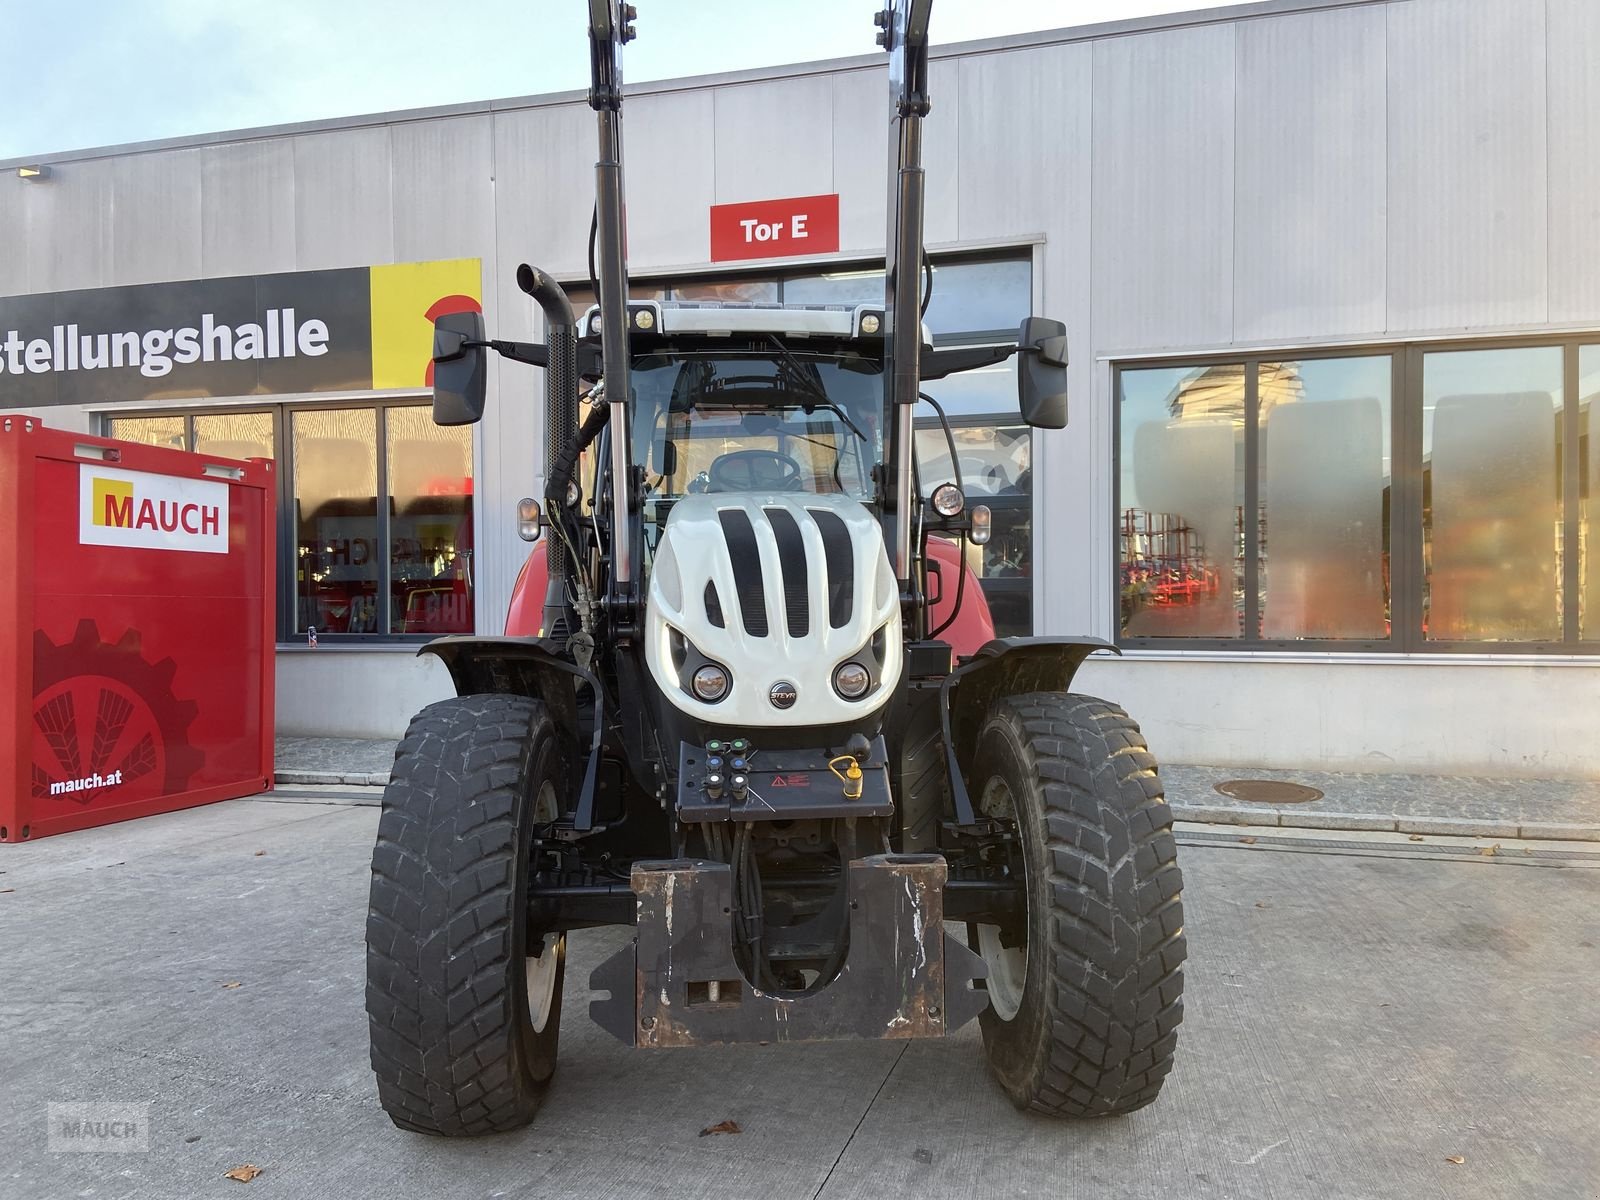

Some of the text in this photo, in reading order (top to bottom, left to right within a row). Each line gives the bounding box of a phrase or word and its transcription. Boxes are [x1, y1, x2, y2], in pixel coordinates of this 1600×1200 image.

[740, 215, 809, 242] Tor E
[0, 308, 329, 377] tellungshalle
[105, 494, 219, 536] MAUCH
[50, 770, 122, 796] mauch.at
